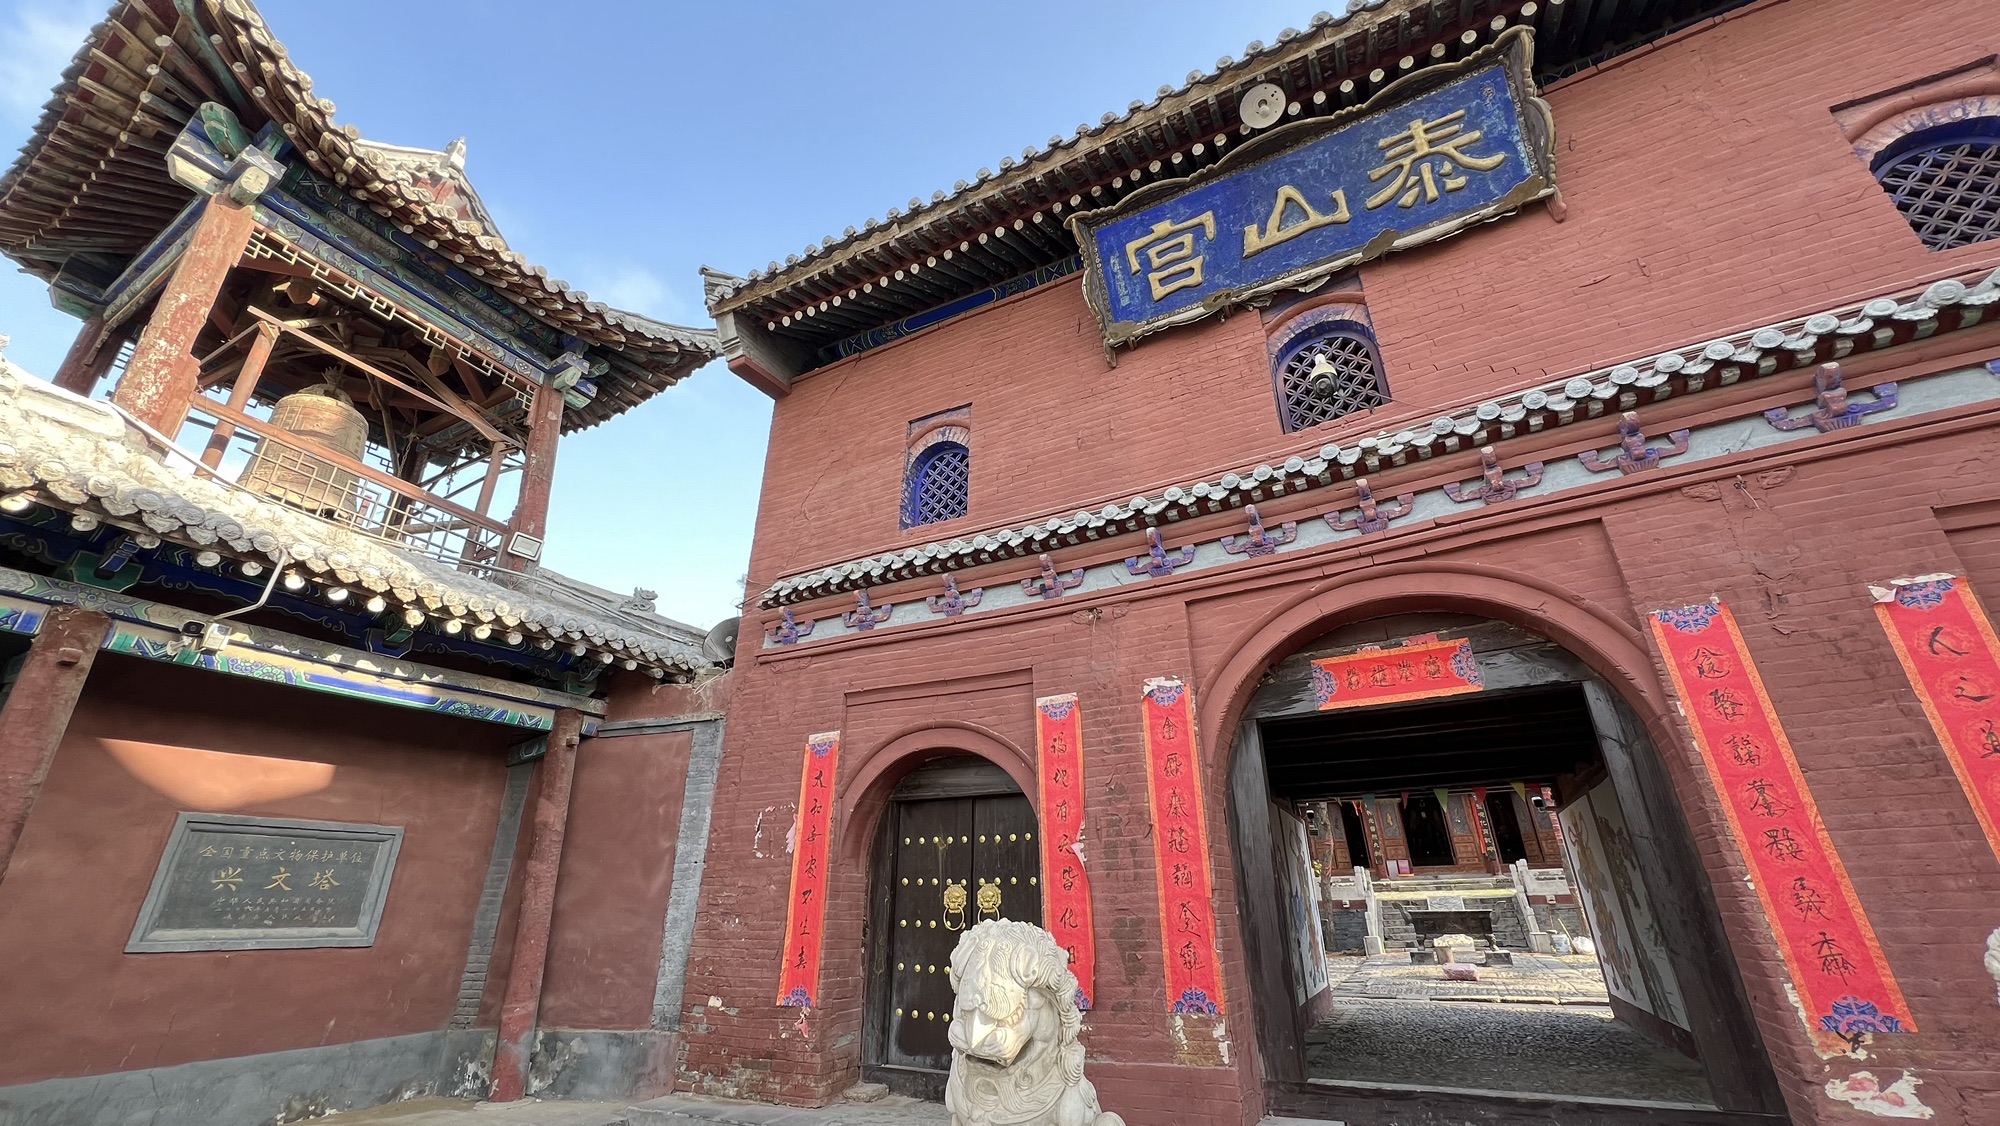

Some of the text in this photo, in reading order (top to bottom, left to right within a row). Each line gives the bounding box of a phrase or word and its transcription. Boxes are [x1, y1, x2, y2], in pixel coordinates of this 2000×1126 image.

[200, 845, 363, 864] 全国重点文物保护单位
[211, 867, 341, 891] 兴文塔
